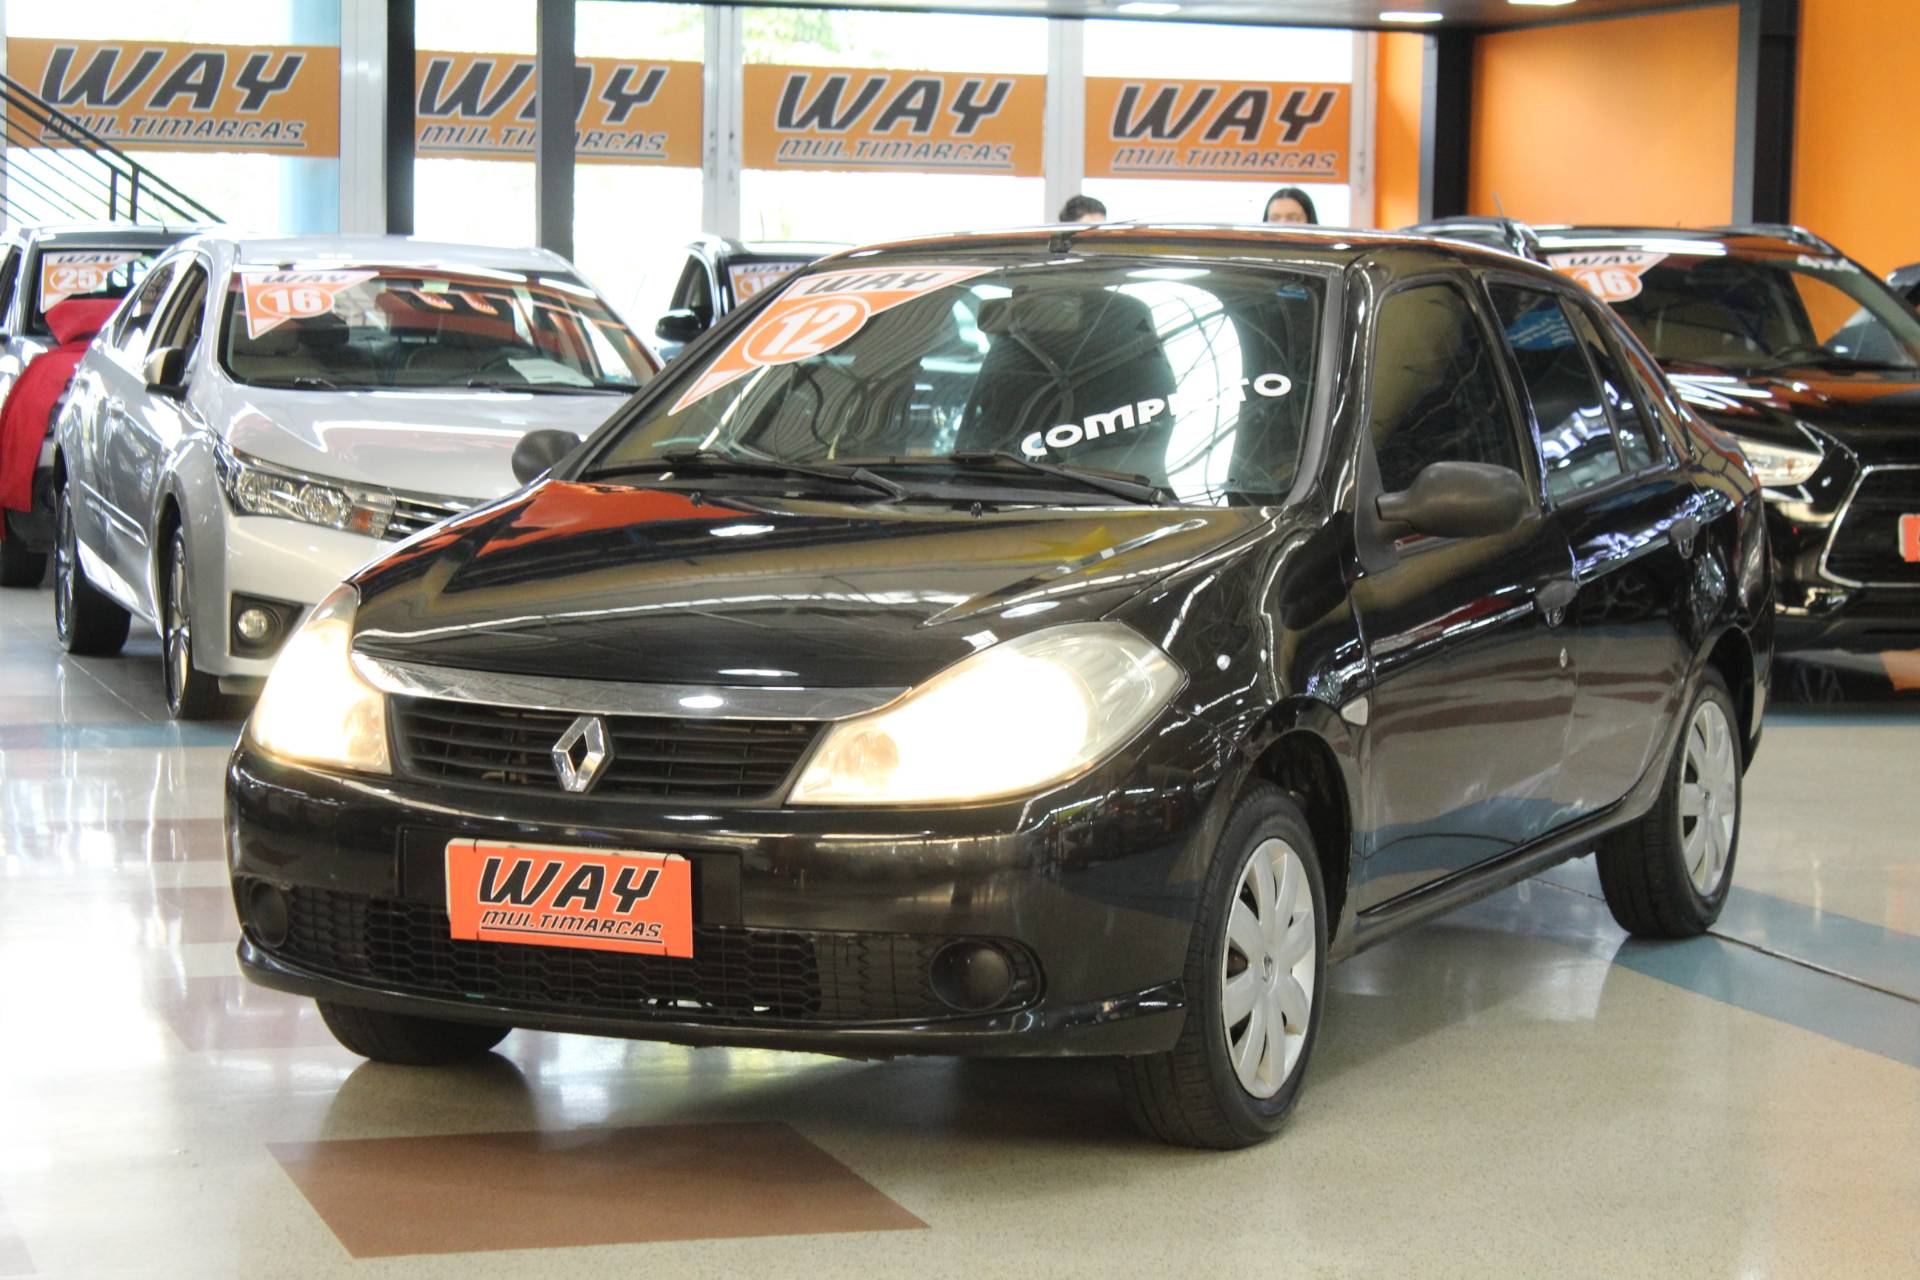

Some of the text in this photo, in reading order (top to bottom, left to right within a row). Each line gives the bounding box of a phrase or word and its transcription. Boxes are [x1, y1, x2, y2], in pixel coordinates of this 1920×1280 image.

[40, 45, 306, 112] WAY
[775, 72, 1015, 136] WAY
[1110, 83, 1339, 145] WAY
[420, 125, 668, 151] MULTIRCAS
[778, 138, 1014, 162] MULTIMARCAS
[1113, 147, 1338, 169] MULTIMARCAS
[1569, 255, 1643, 266] WAY
[58, 267, 98, 289] 25
[803, 272, 943, 294] WAY
[1578, 270, 1634, 296] 16
[266, 288, 324, 313] 16
[760, 304, 858, 356] 12
[478, 856, 662, 915] WAY
[480, 910, 663, 938] MULTIMARCAS
